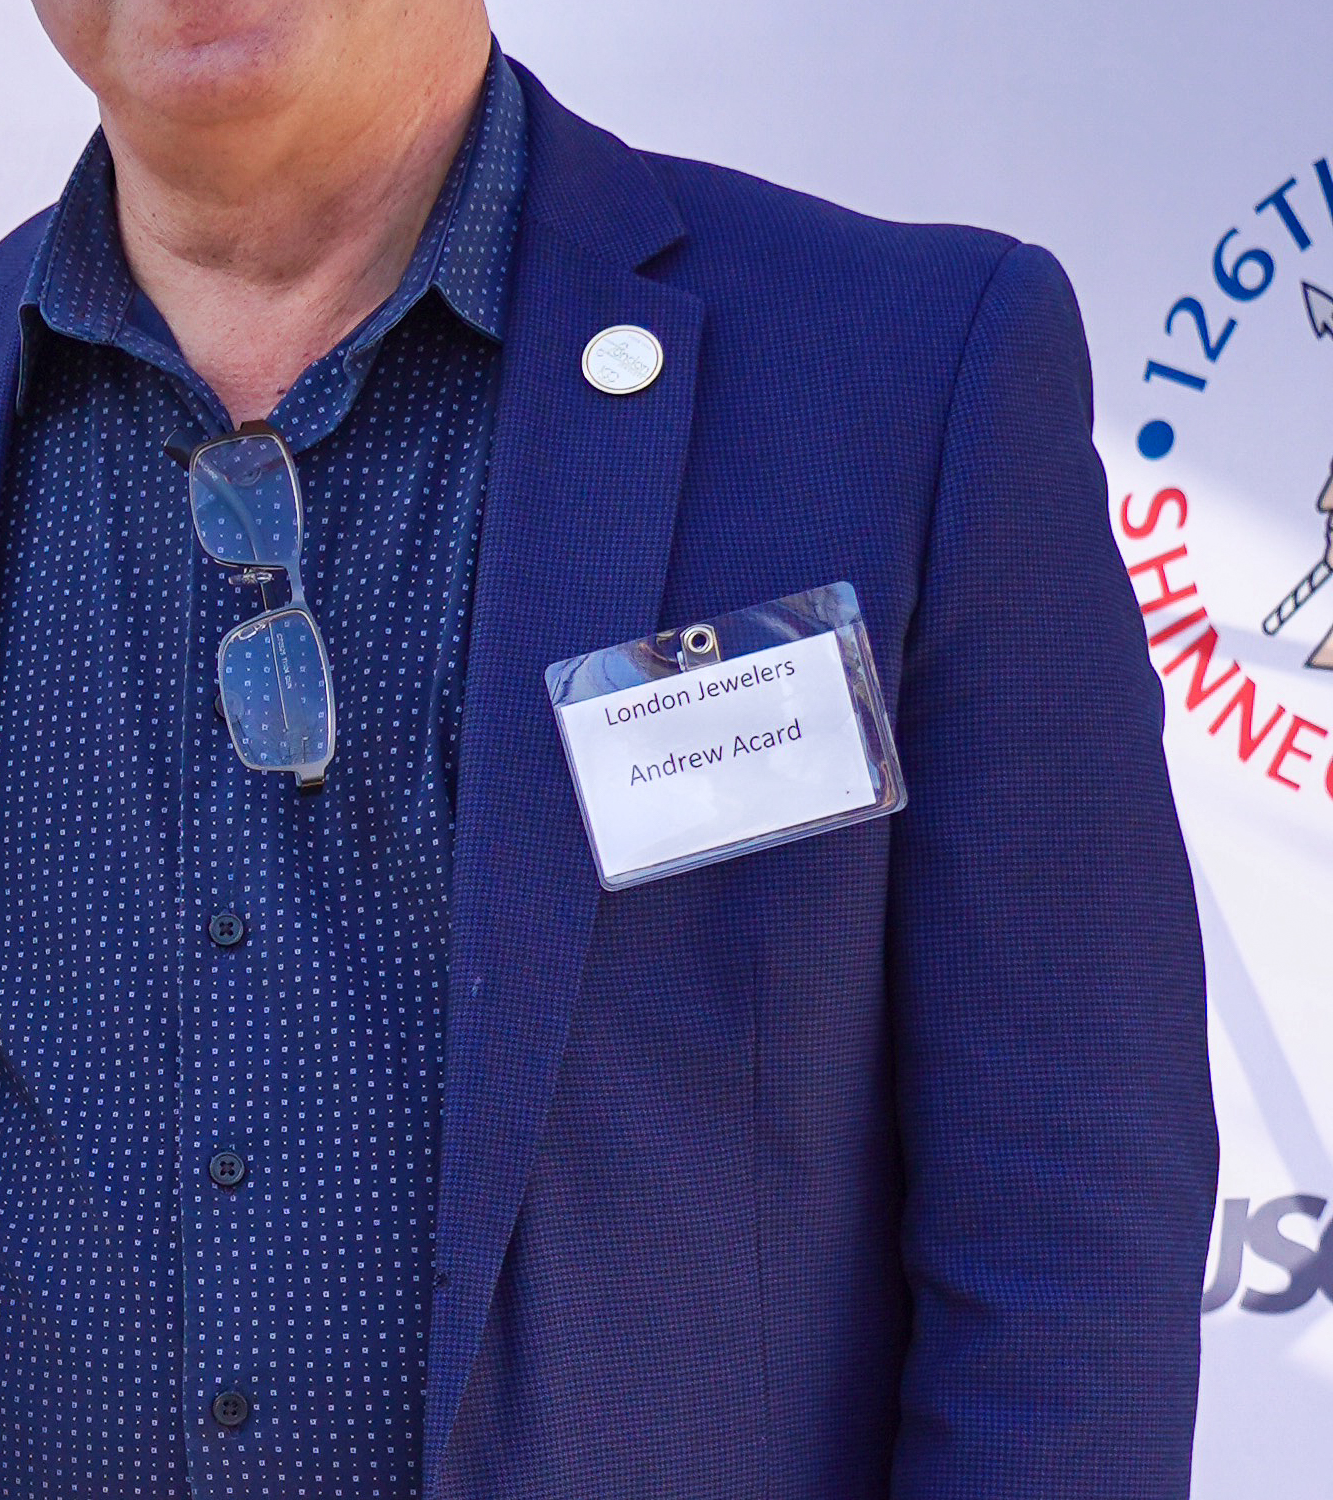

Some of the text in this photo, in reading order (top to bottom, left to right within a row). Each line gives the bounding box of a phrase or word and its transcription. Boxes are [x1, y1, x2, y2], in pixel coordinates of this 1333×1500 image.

[605, 658, 796, 726] London Jewelers
[629, 718, 803, 787] Andrew Acard
